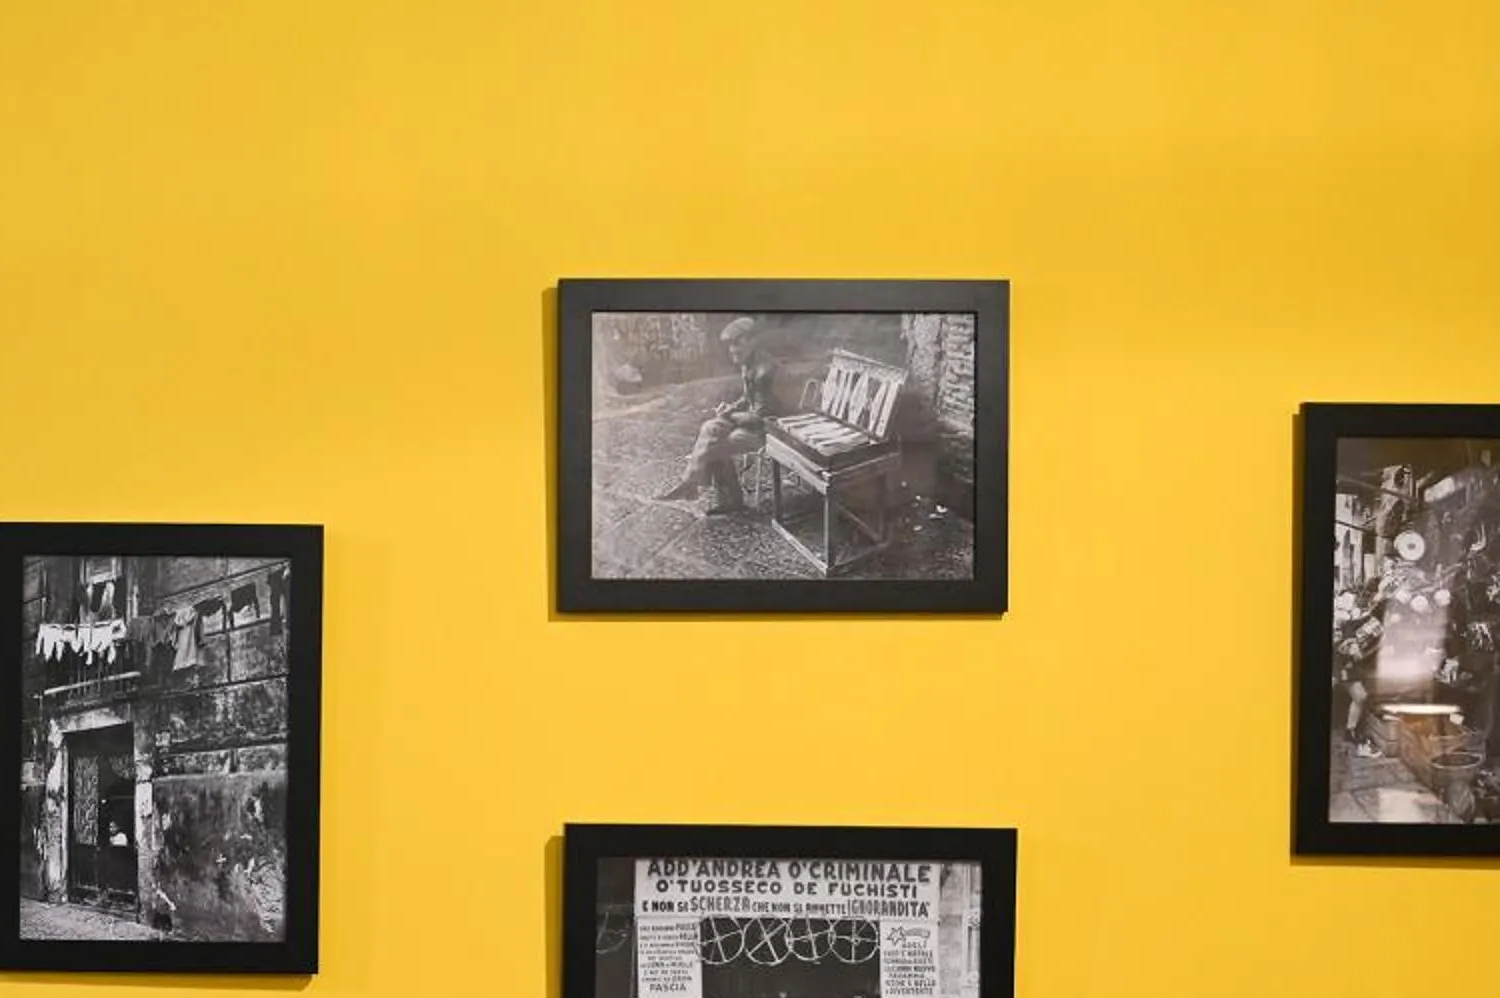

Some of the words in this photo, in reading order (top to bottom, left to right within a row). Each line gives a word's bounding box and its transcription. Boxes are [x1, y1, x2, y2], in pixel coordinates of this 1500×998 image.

[787, 860, 931, 883] O'CRIMINALE
[656, 880, 782, 895] O'TUOSSECO
[793, 881, 818, 895] DE
[827, 882, 918, 898] FUCHISTI
[651, 900, 674, 912] NON
